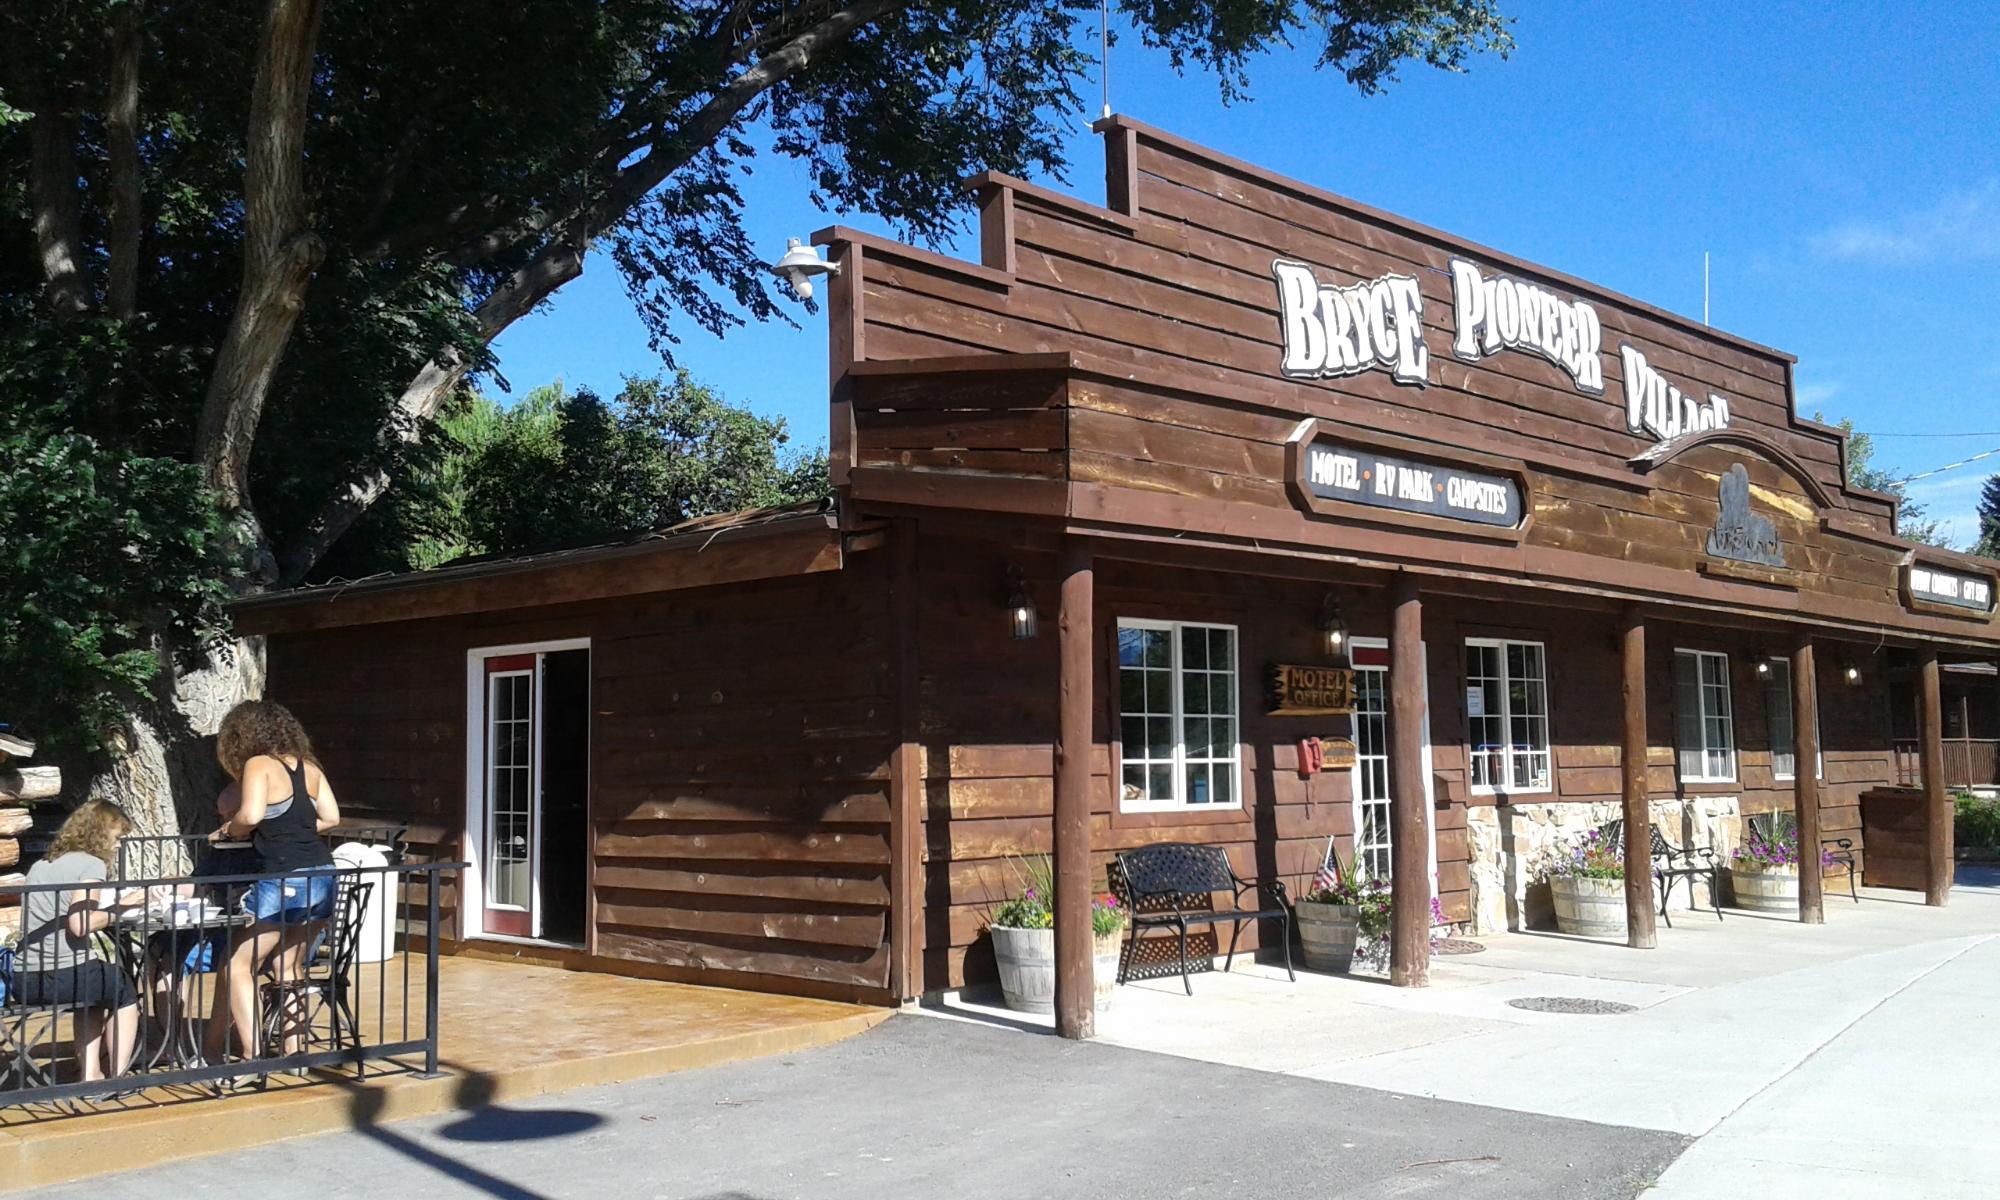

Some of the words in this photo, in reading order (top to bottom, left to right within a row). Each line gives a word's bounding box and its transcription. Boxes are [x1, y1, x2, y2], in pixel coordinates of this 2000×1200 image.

[1274, 260, 1429, 385] BRYCE
[1450, 258, 1604, 393] PIONEER
[1310, 450, 1361, 491] MOTEL
[1374, 462, 1397, 497] RV
[1397, 464, 1434, 503] PARK
[1447, 476, 1508, 515] CAMPSITES
[1291, 668, 1345, 690] MOTEL
[1294, 690, 1341, 707] OFFICE
